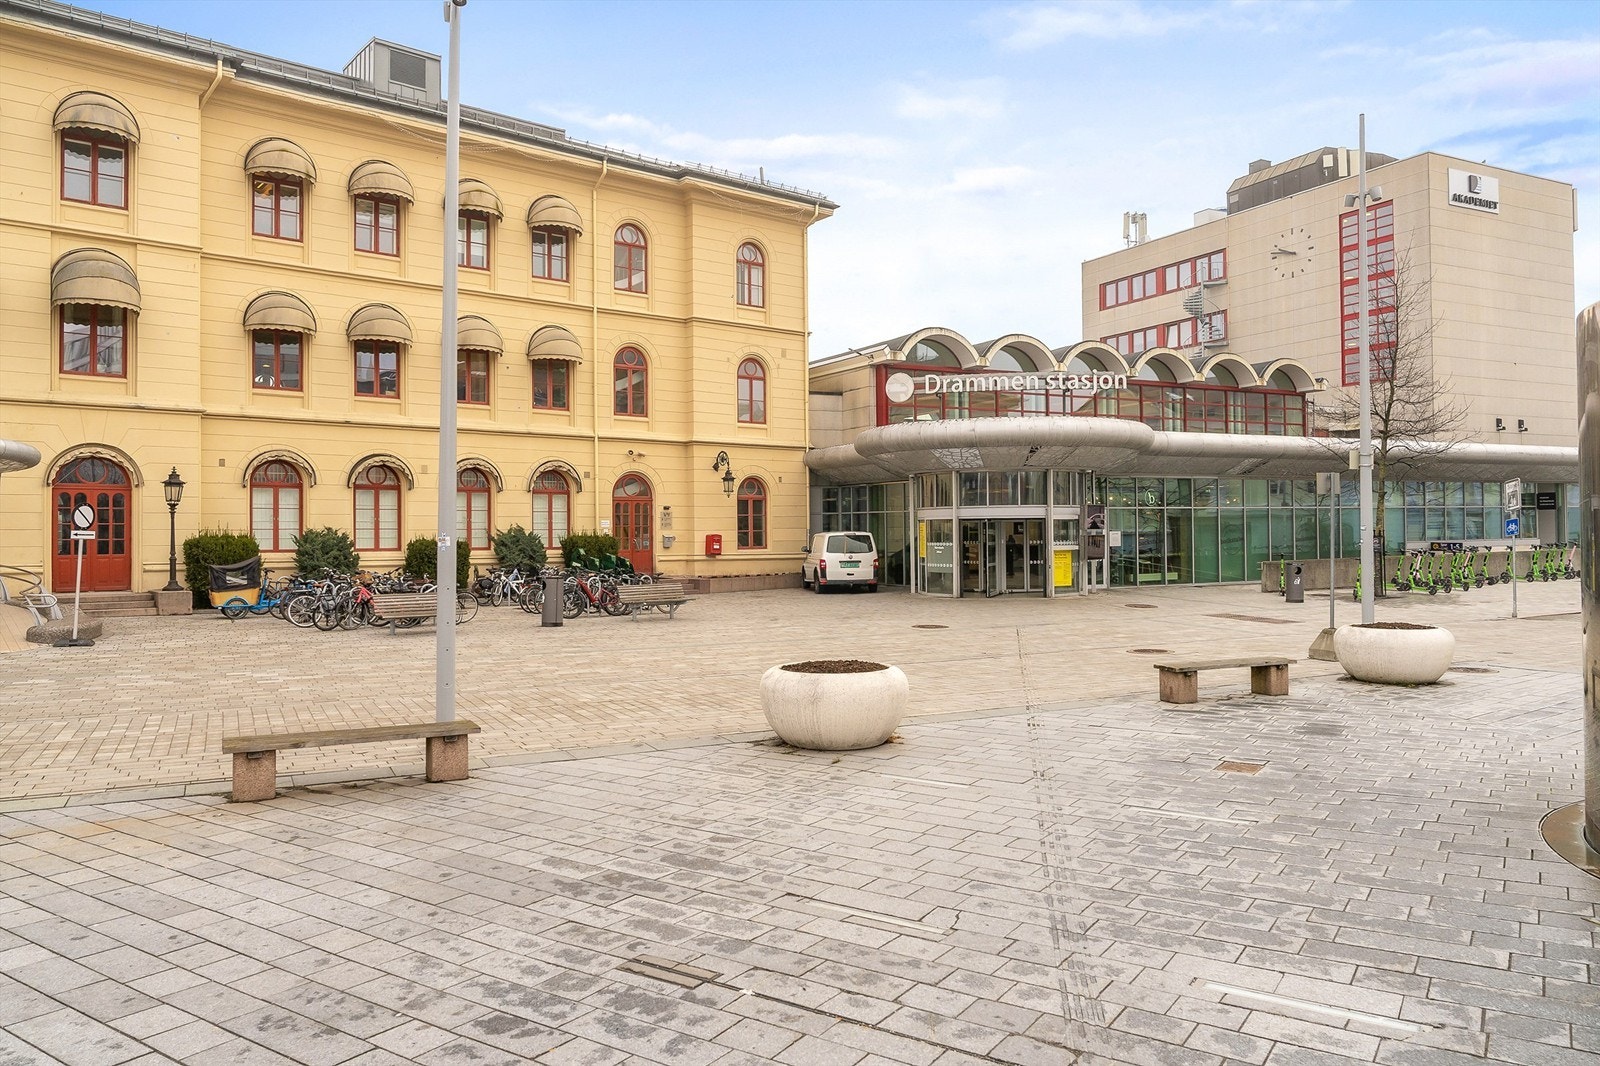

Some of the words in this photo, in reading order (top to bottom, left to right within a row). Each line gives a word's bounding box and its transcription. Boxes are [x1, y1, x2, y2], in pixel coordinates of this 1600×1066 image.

[1451, 193, 1499, 210] AKADEMIET
[925, 374, 1039, 394] Drammen
[1046, 369, 1128, 395] stasjon
